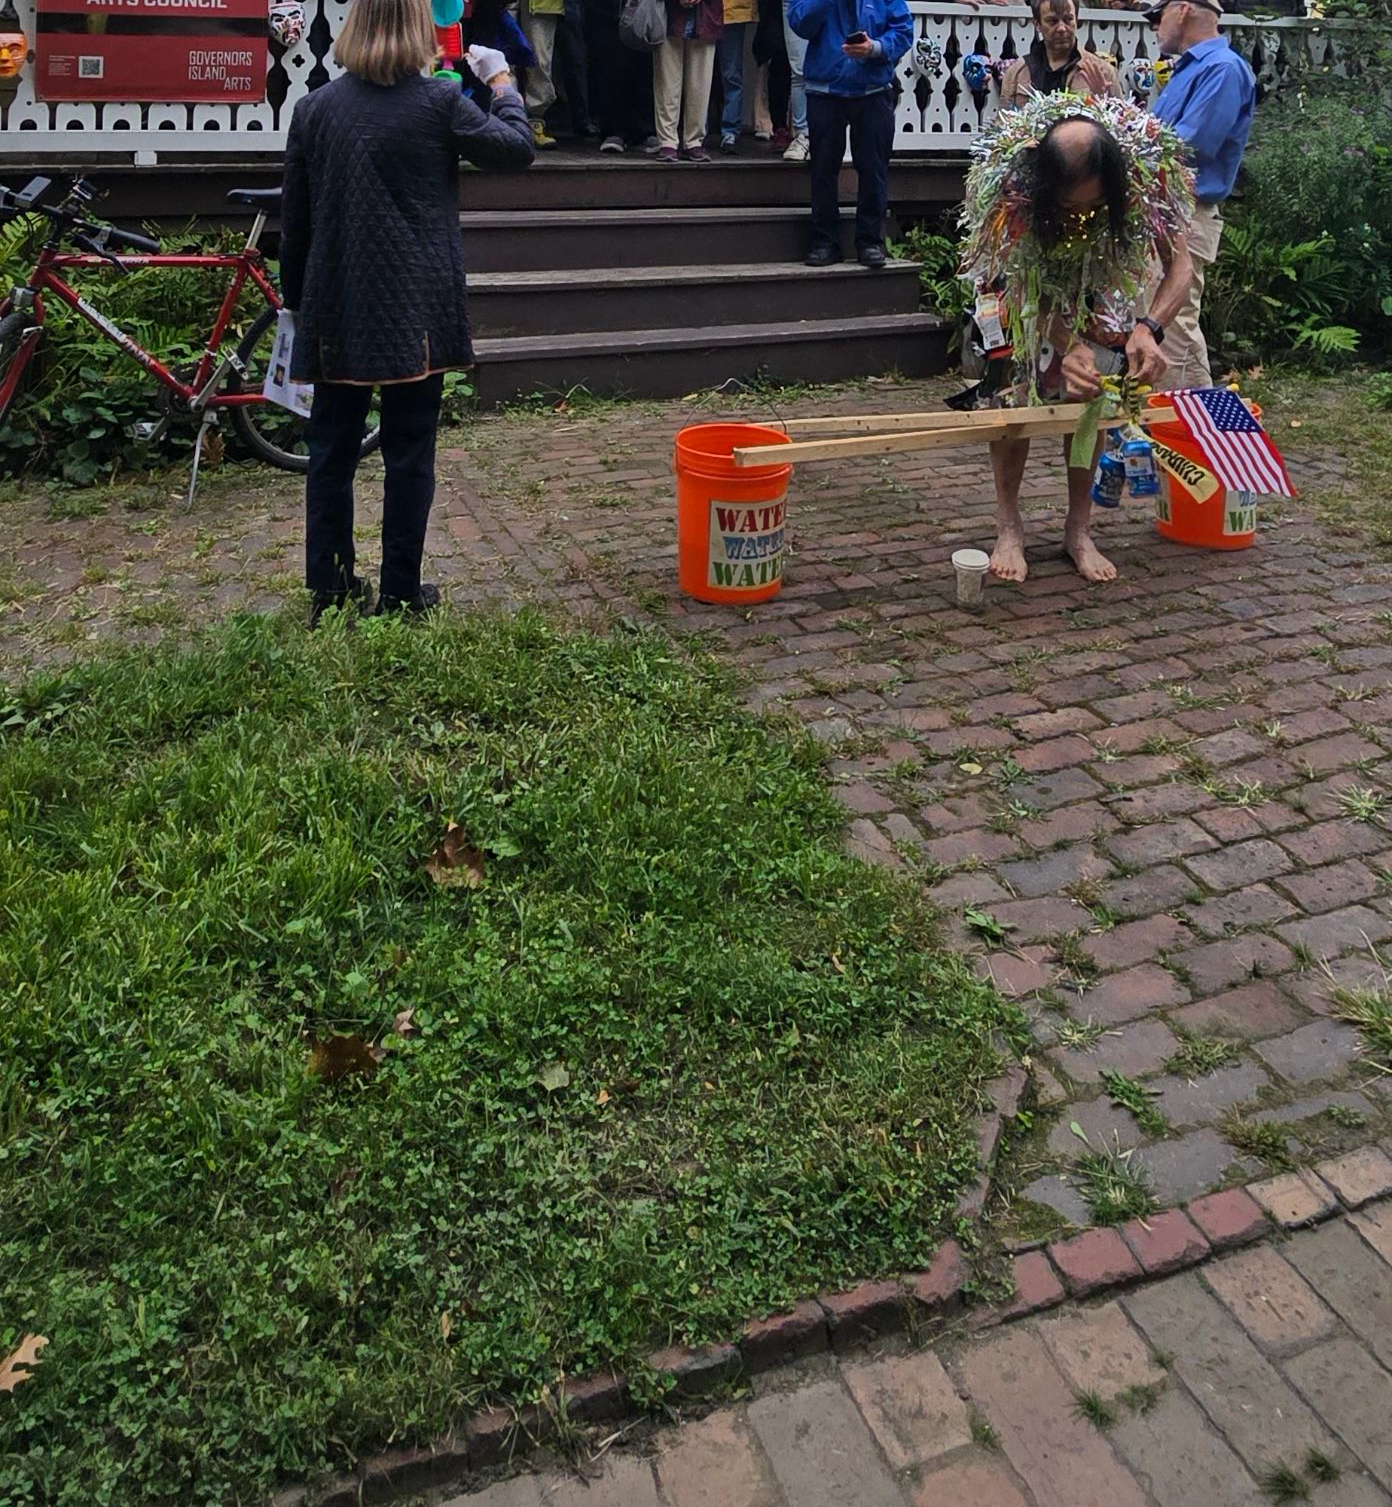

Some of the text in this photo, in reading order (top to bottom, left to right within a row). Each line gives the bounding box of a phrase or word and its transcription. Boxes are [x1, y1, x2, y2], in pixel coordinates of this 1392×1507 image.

[189, 50, 253, 66] GOVERNORS
[188, 65, 226, 81] ISLAND
[223, 76, 252, 91] ARTS
[715, 501, 787, 533] WATE
[712, 555, 783, 587] WATE
